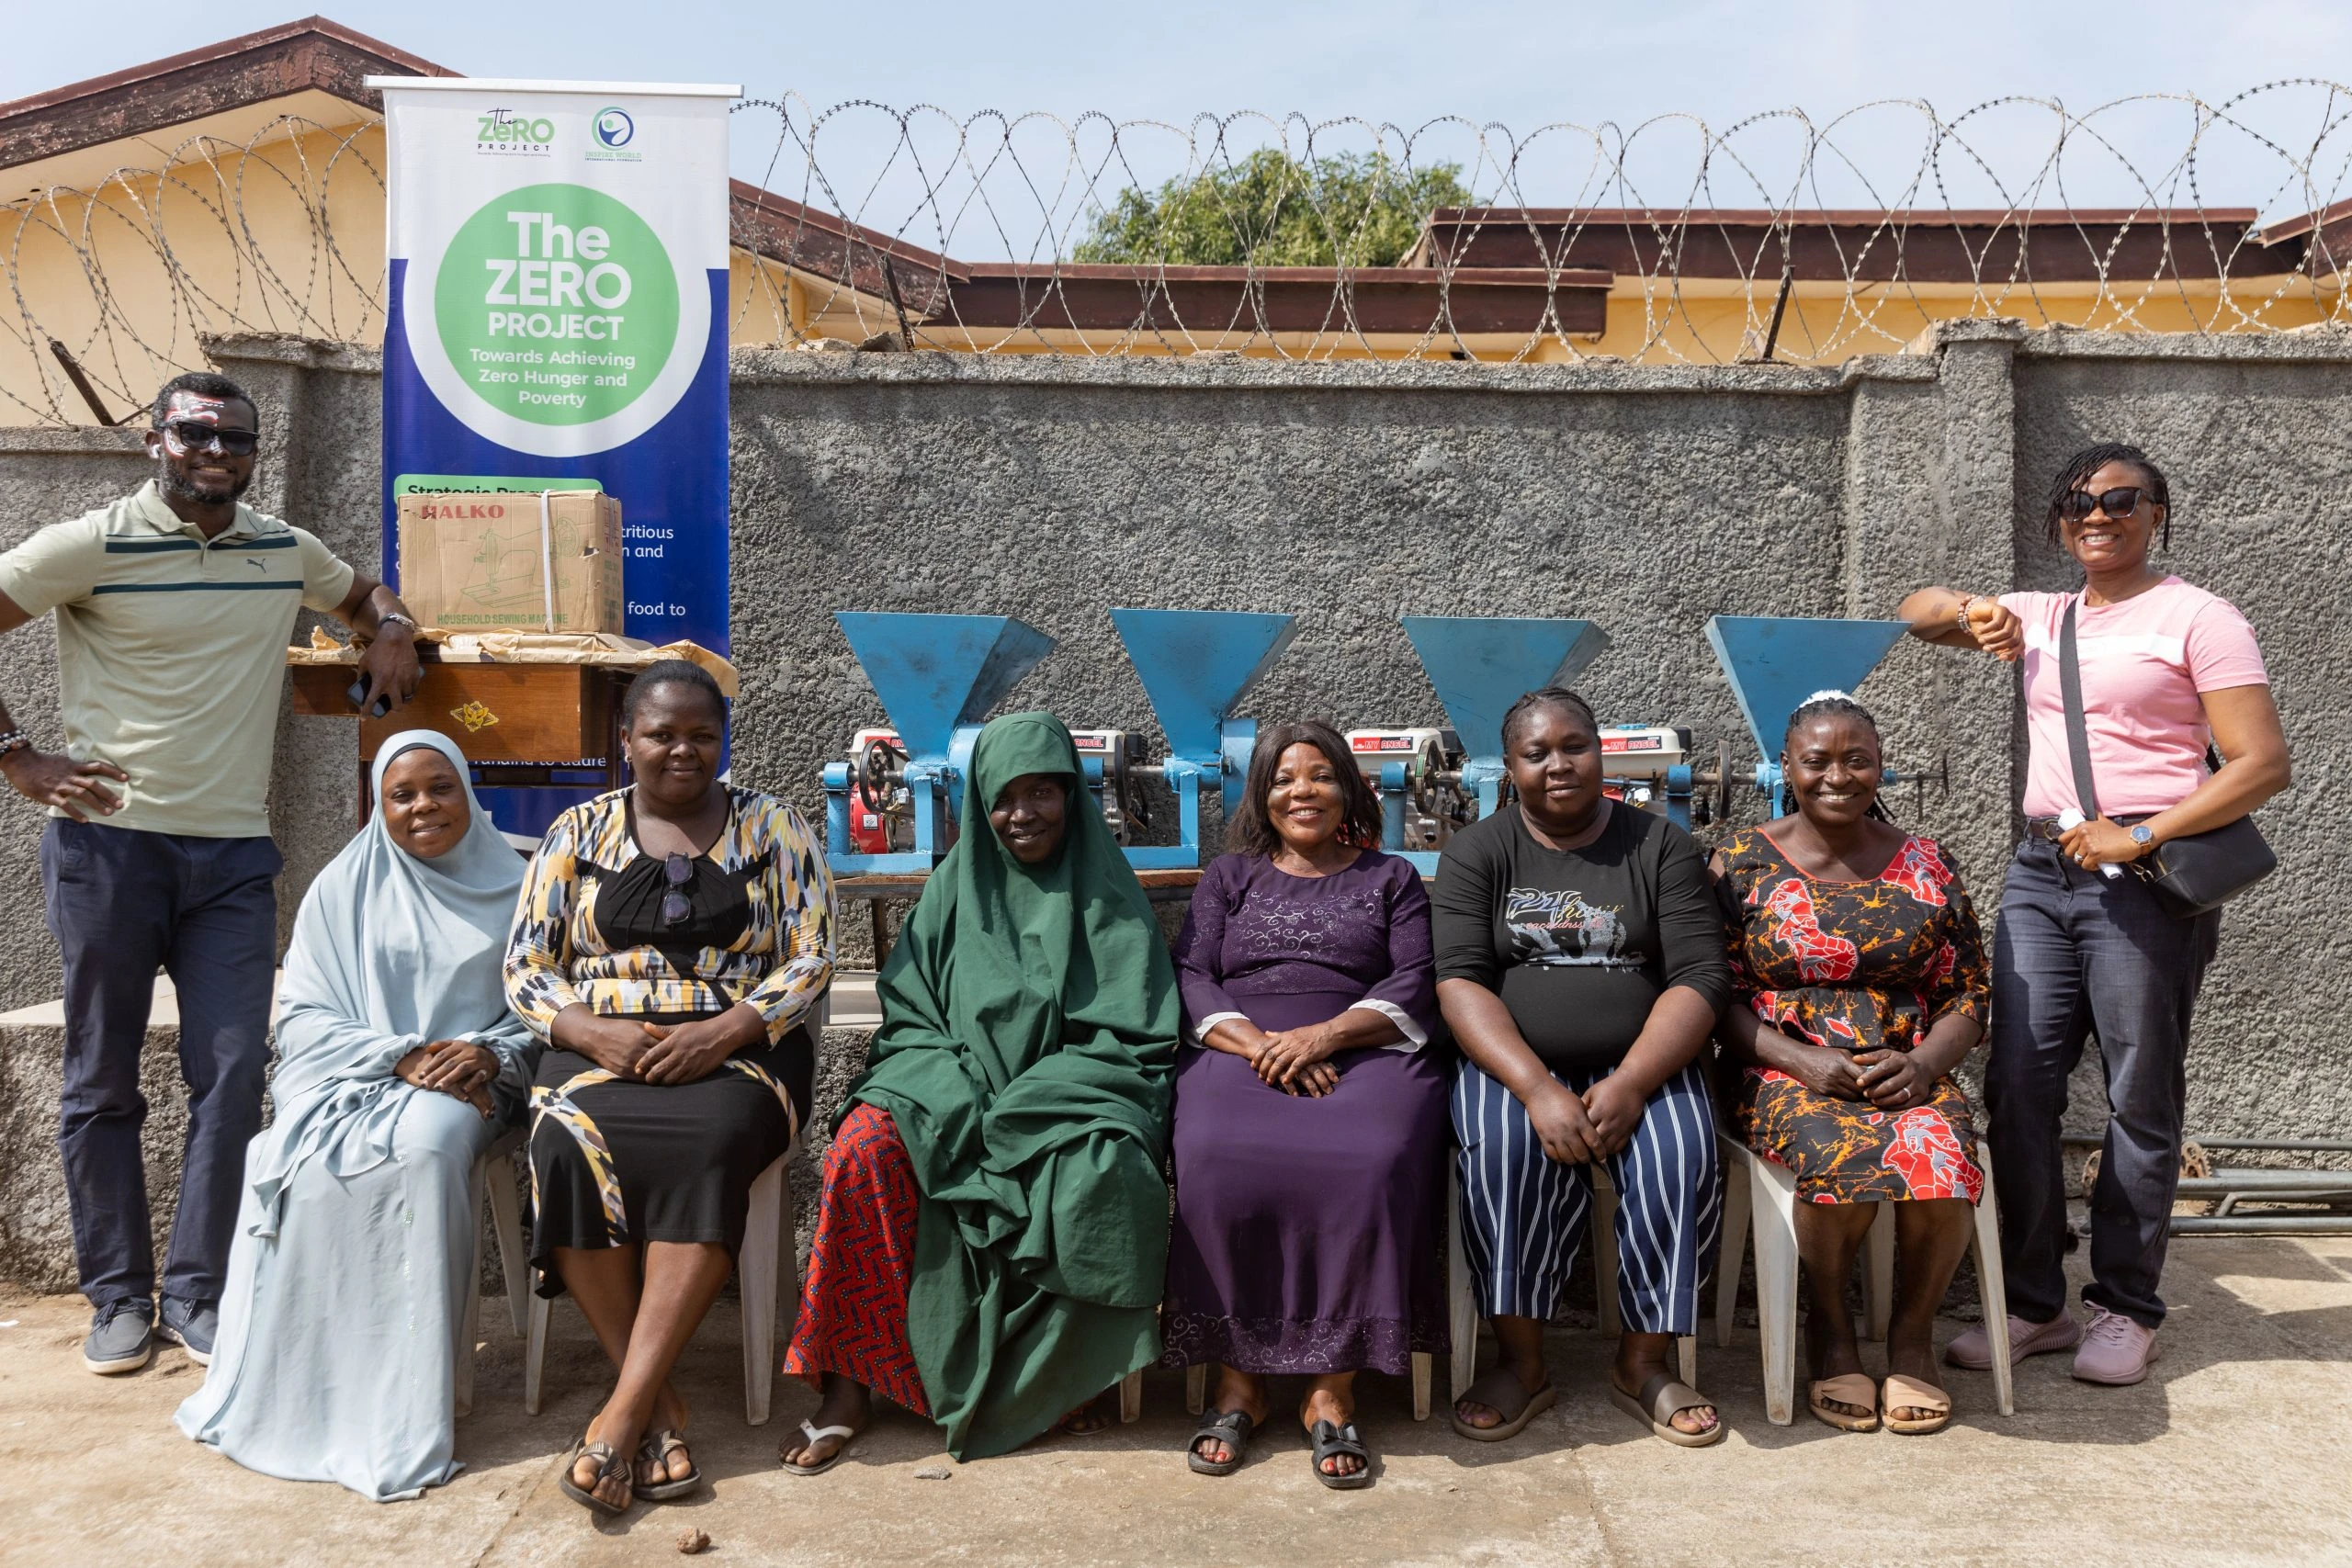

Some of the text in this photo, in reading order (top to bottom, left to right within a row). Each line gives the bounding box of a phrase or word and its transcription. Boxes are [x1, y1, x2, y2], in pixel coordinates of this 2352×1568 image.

[487, 107, 517, 130] The
[478, 118, 555, 143] ZeRO
[478, 143, 549, 152] PROJECT
[507, 211, 611, 261] The
[485, 258, 632, 310] ZERO
[488, 311, 625, 341] PROJECT
[469, 348, 636, 369] Towards Achieving
[479, 368, 628, 388] Zero Hunger and
[518, 390, 587, 409] Poverty
[635, 545, 663, 558] and
[628, 601, 686, 616] food to
[437, 613, 568, 625] HOUSEHOLD SEWING MACINE
[1074, 738, 1104, 748] ANGEL
[1365, 740, 1380, 749] MY
[1381, 739, 1411, 749] ANGEL
[1611, 741, 1626, 750] MY
[1628, 739, 1660, 750] ANGEL
